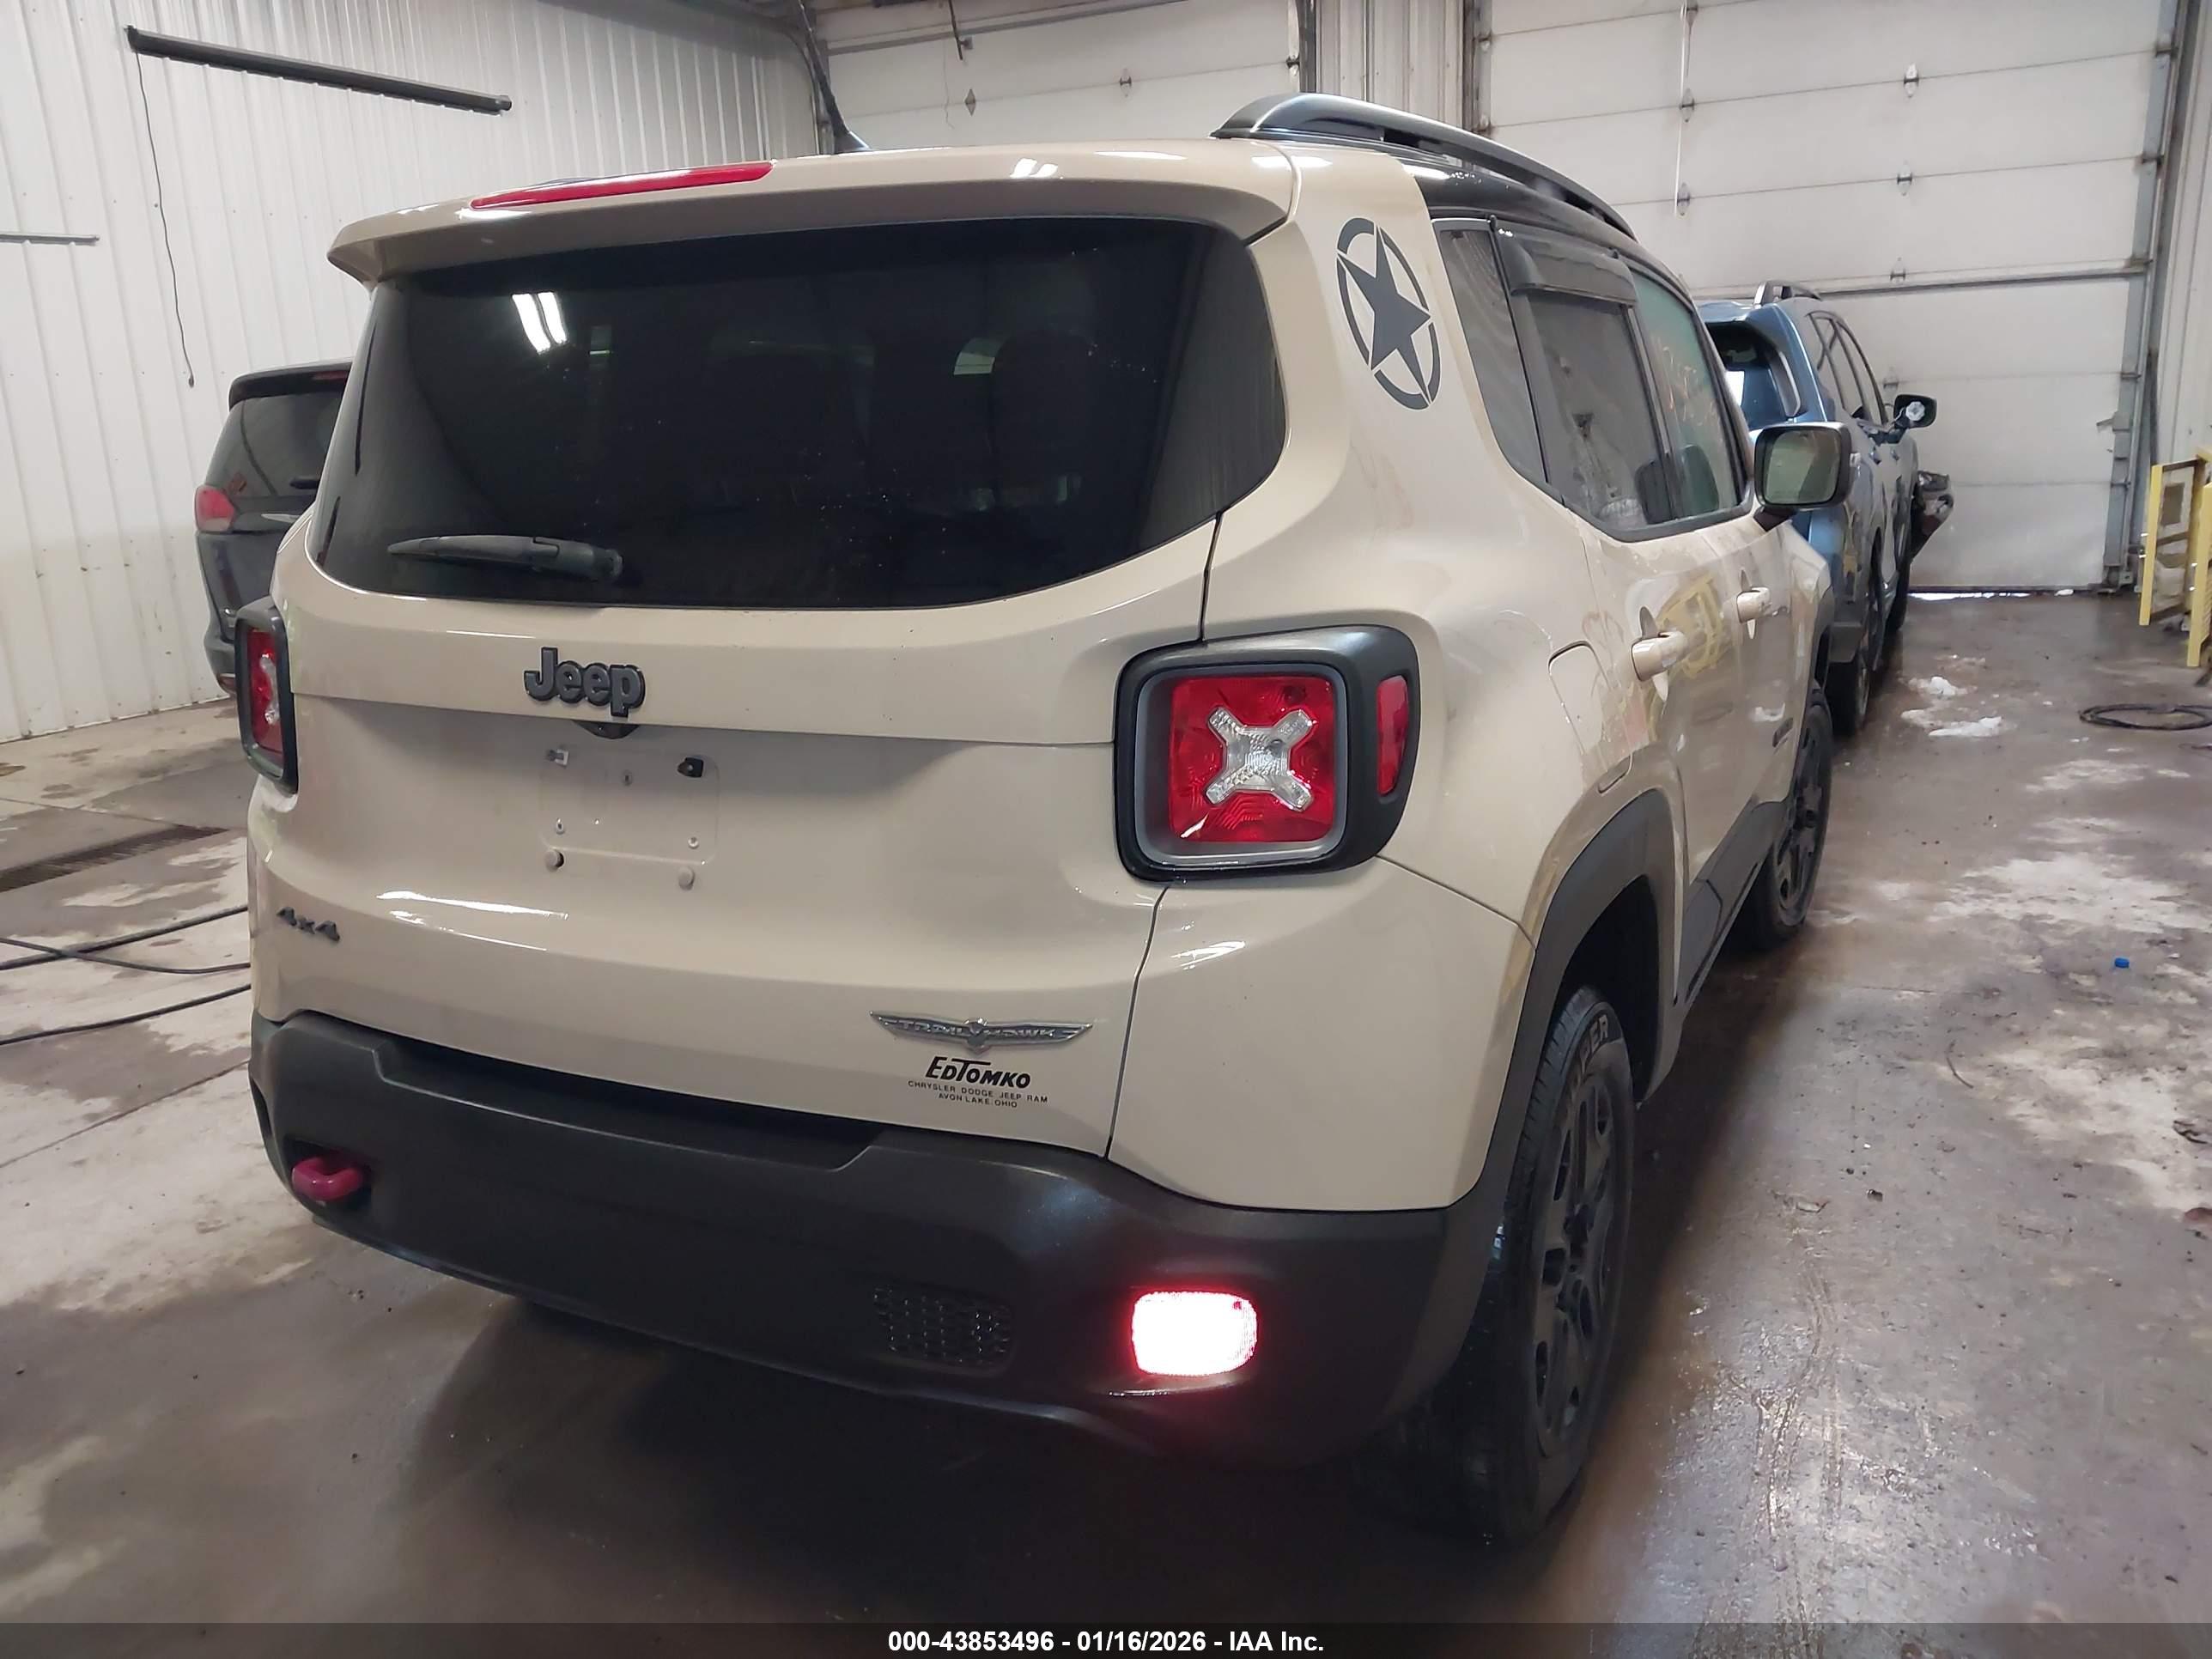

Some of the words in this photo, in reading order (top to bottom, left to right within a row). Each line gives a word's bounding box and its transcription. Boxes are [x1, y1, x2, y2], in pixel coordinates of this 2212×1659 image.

[524, 647, 646, 718] Jeep
[908, 1080, 956, 1093] CHRYSLER
[961, 1087, 994, 1098] DODGE
[1000, 1091, 1022, 1100] JEEP
[1027, 1094, 1048, 1103] RAM
[939, 1092, 963, 1101] AVON
[994, 1099, 1018, 1108] OHIO
